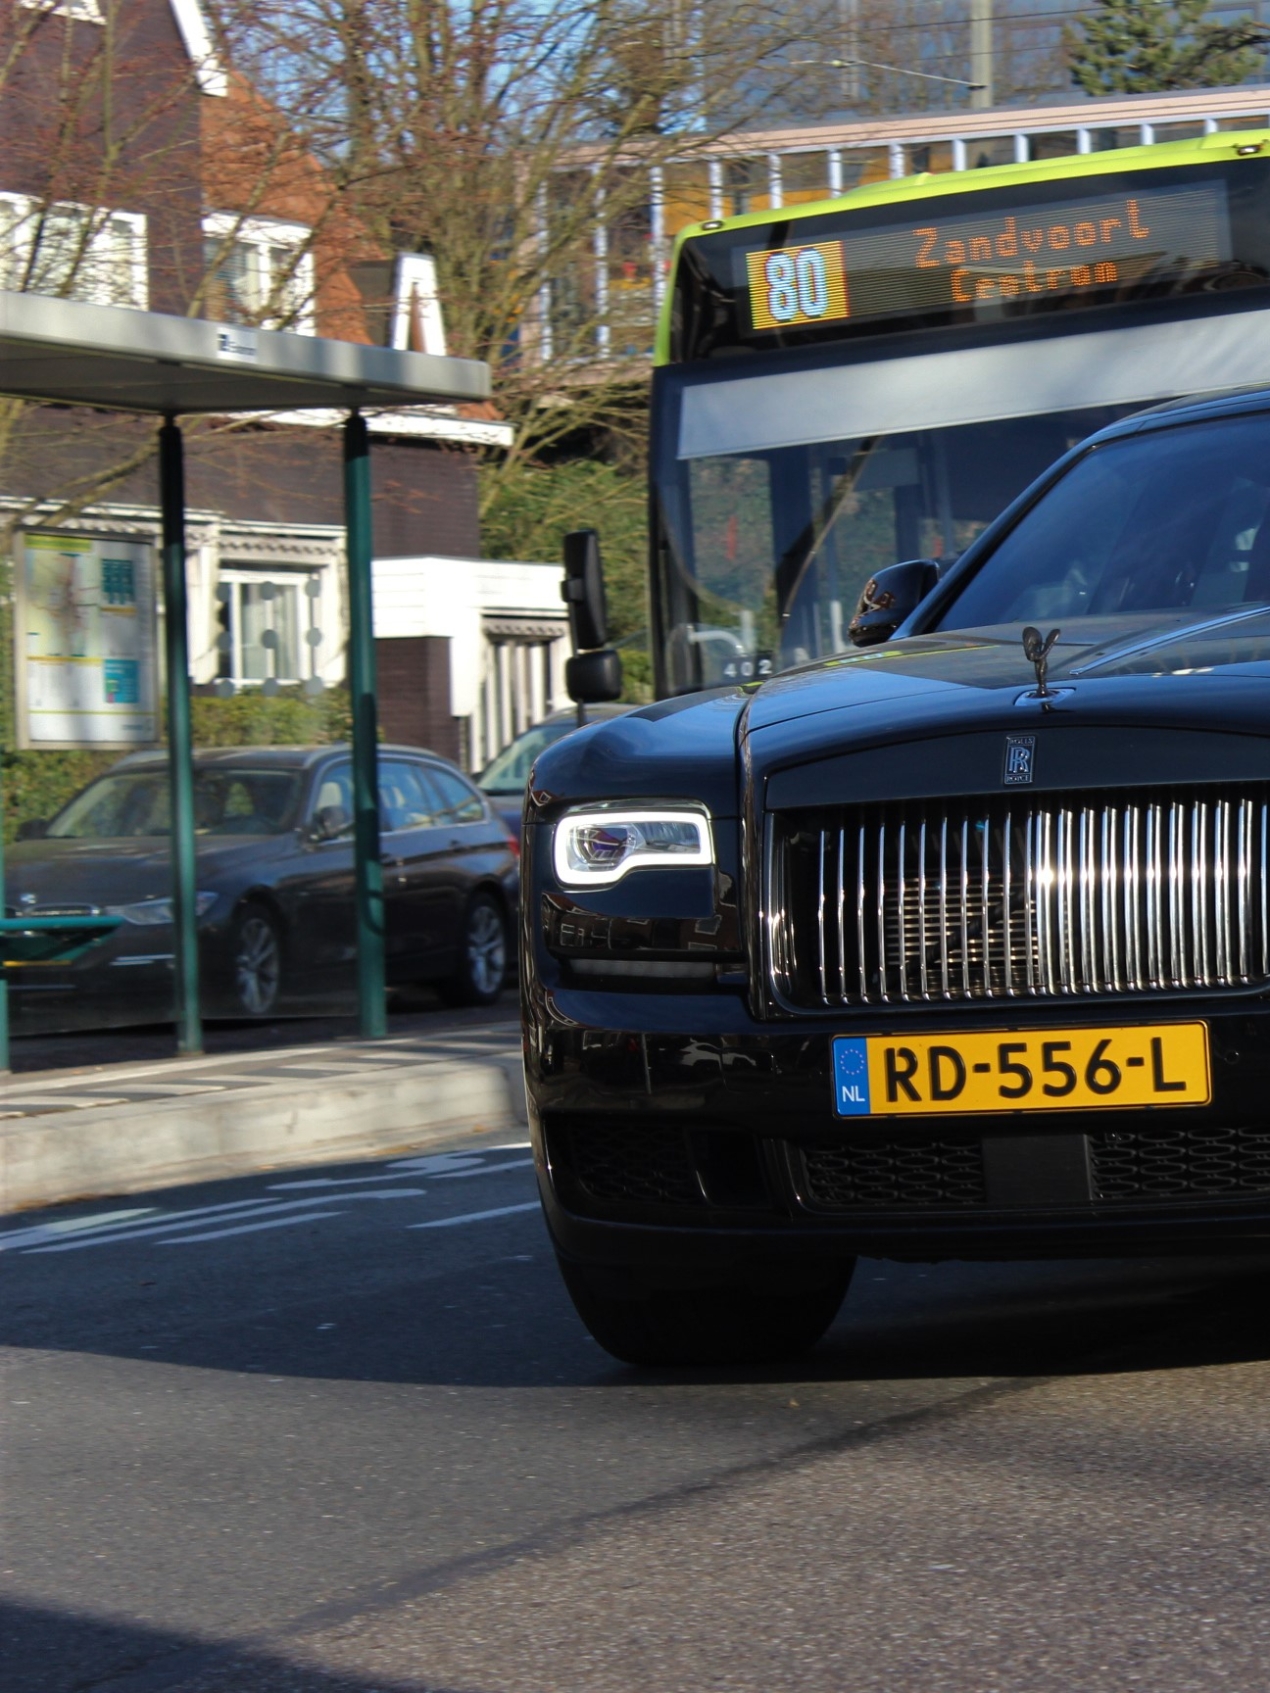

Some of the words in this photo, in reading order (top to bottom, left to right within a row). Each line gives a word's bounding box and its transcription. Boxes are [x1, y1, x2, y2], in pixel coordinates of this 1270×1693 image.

[913, 199, 1149, 268] Zandvoort
[765, 247, 829, 322] 80
[724, 659, 772, 678] 402
[842, 1085, 866, 1103] NL
[884, 1036, 1187, 1102] RD-556-L
